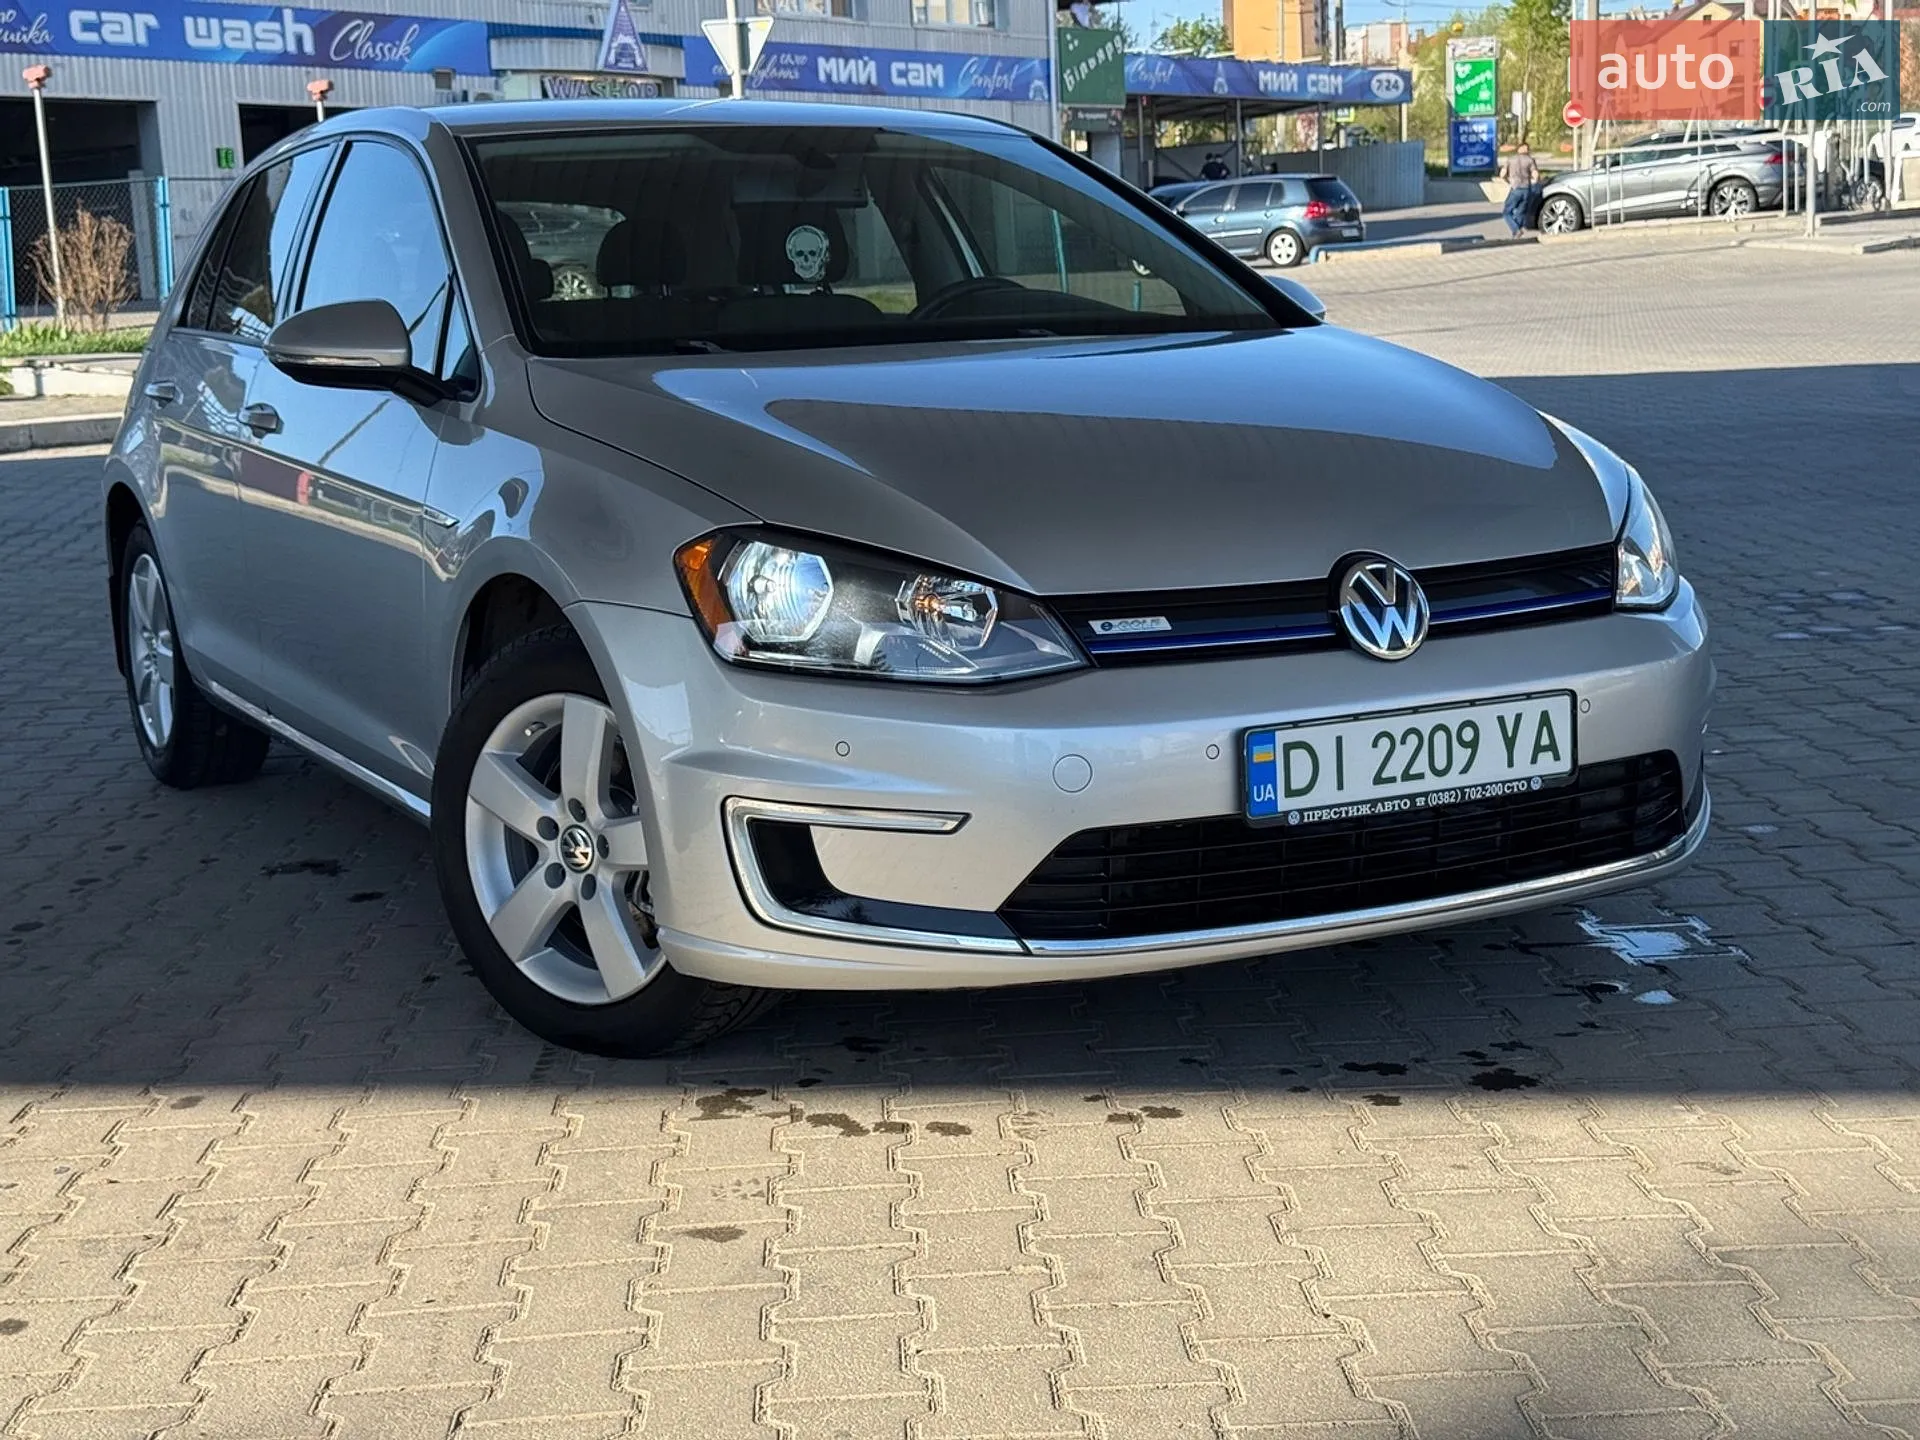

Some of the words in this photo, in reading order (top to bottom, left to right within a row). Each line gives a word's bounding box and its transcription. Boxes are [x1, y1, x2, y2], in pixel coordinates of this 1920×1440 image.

[69, 9, 159, 48] car
[183, 10, 315, 56] wash
[329, 19, 420, 62] Classik
[957, 55, 1019, 98] Comfort
[1282, 734, 1344, 799] DI
[1371, 719, 1480, 786] 2209
[1496, 709, 1561, 769] YA
[1253, 783, 1275, 802] UA
[1302, 798, 1411, 823] ПРЕСТИЖ-АВТО
[1427, 790, 1461, 807] (0382)
[1464, 784, 1503, 801] 702-200
[1504, 781, 1527, 793] СТО
